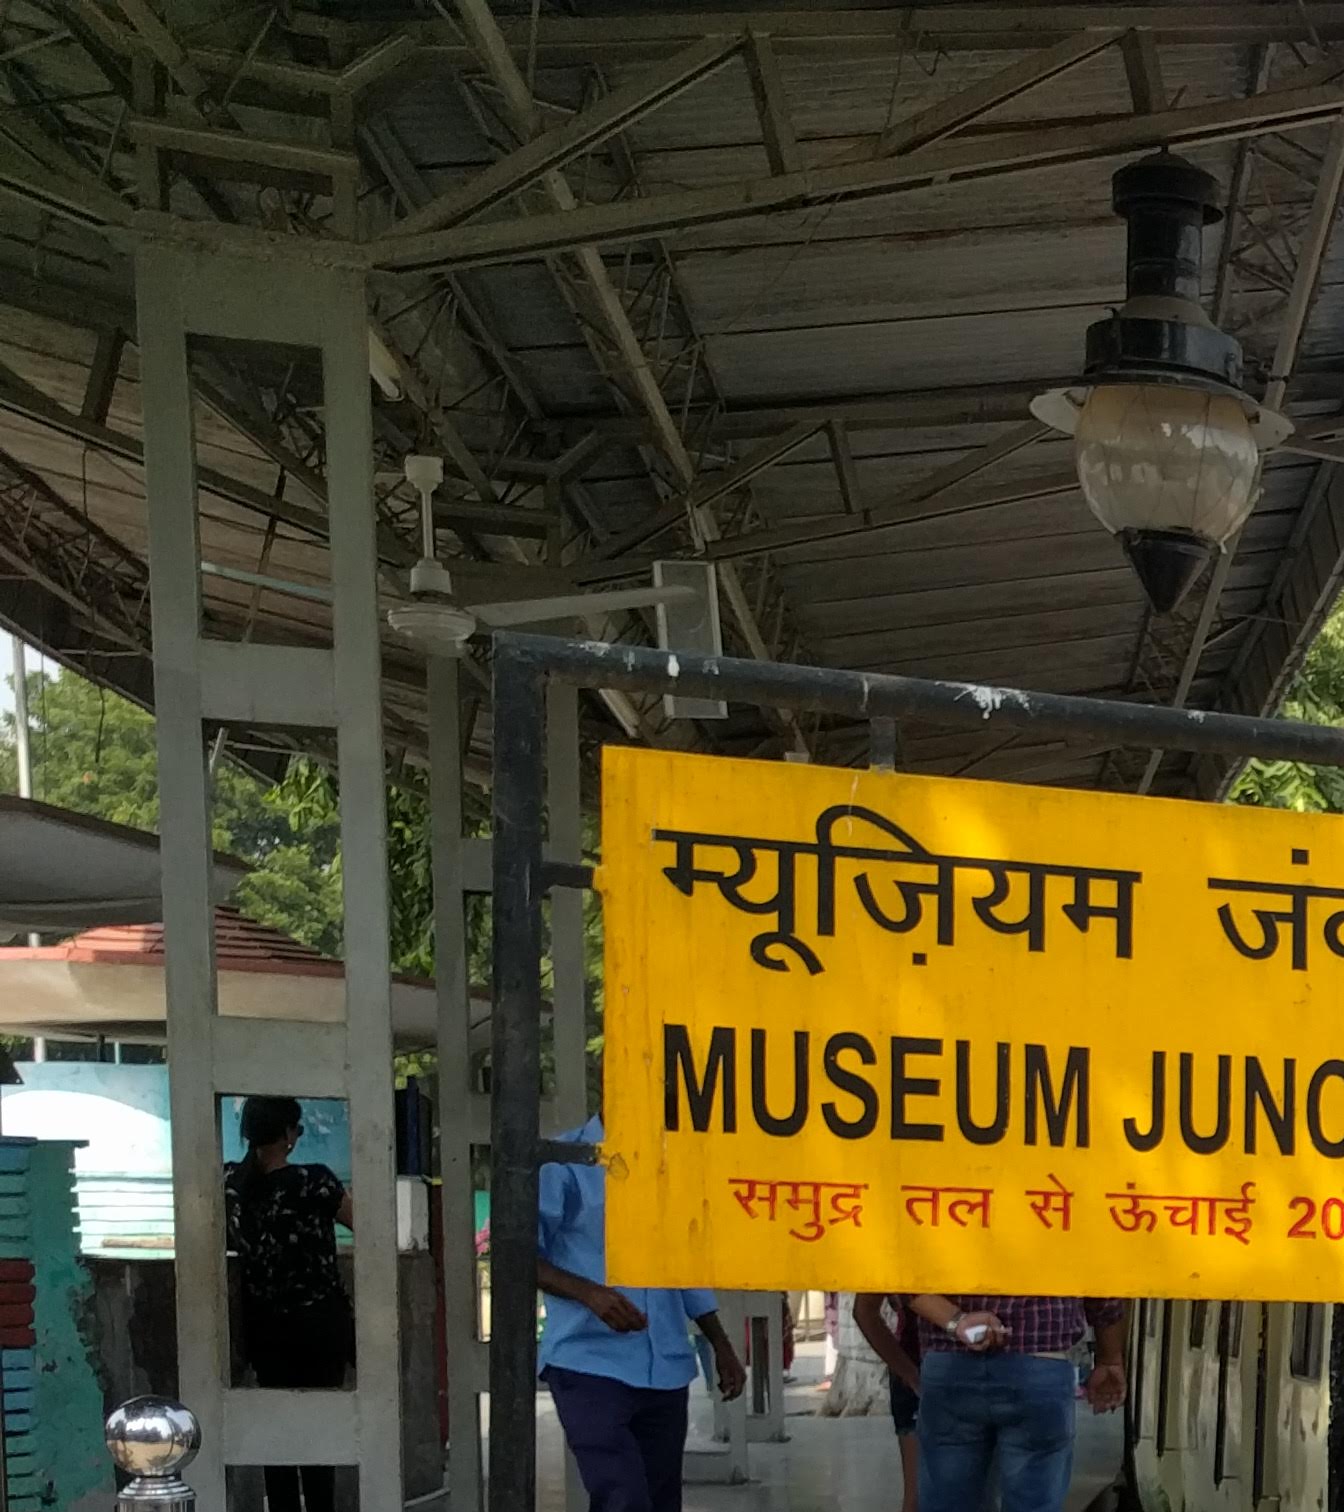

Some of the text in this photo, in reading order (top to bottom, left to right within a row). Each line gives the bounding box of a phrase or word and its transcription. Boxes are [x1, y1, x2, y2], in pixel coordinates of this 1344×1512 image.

[651, 804, 1142, 976] म्यूज़ियम
[662, 1020, 1090, 1148] MUSEUM
[727, 1176, 869, 1243] समुद्र
[900, 1183, 994, 1230] तल
[1024, 1172, 1075, 1232] से
[1104, 1181, 1256, 1245] ऊंचाई
